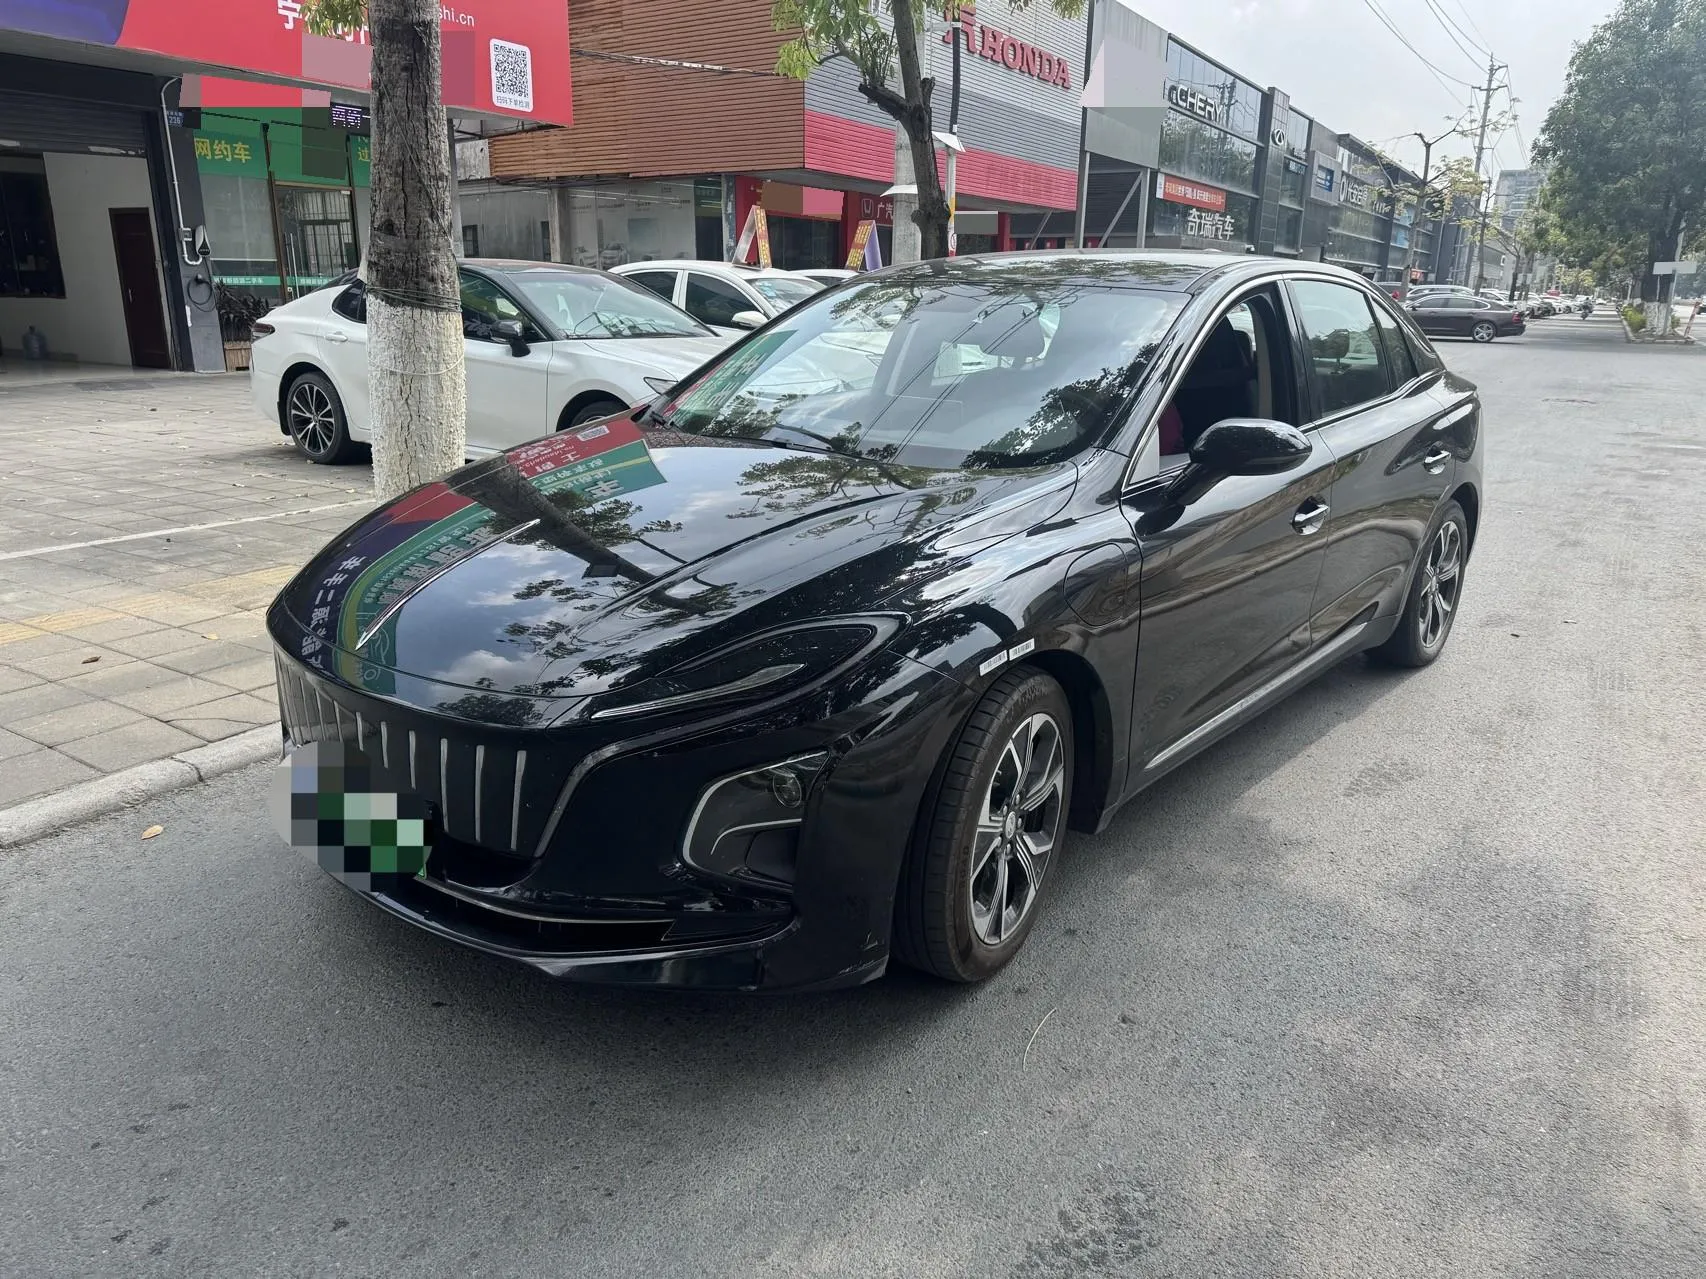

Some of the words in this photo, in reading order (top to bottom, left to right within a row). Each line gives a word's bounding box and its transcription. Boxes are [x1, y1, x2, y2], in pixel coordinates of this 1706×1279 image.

[980, 25, 1071, 89] HONDA
[1177, 83, 1222, 122] CHERY
[193, 137, 252, 163] 网约车
[1187, 207, 1235, 241] 奇瑞汽车
